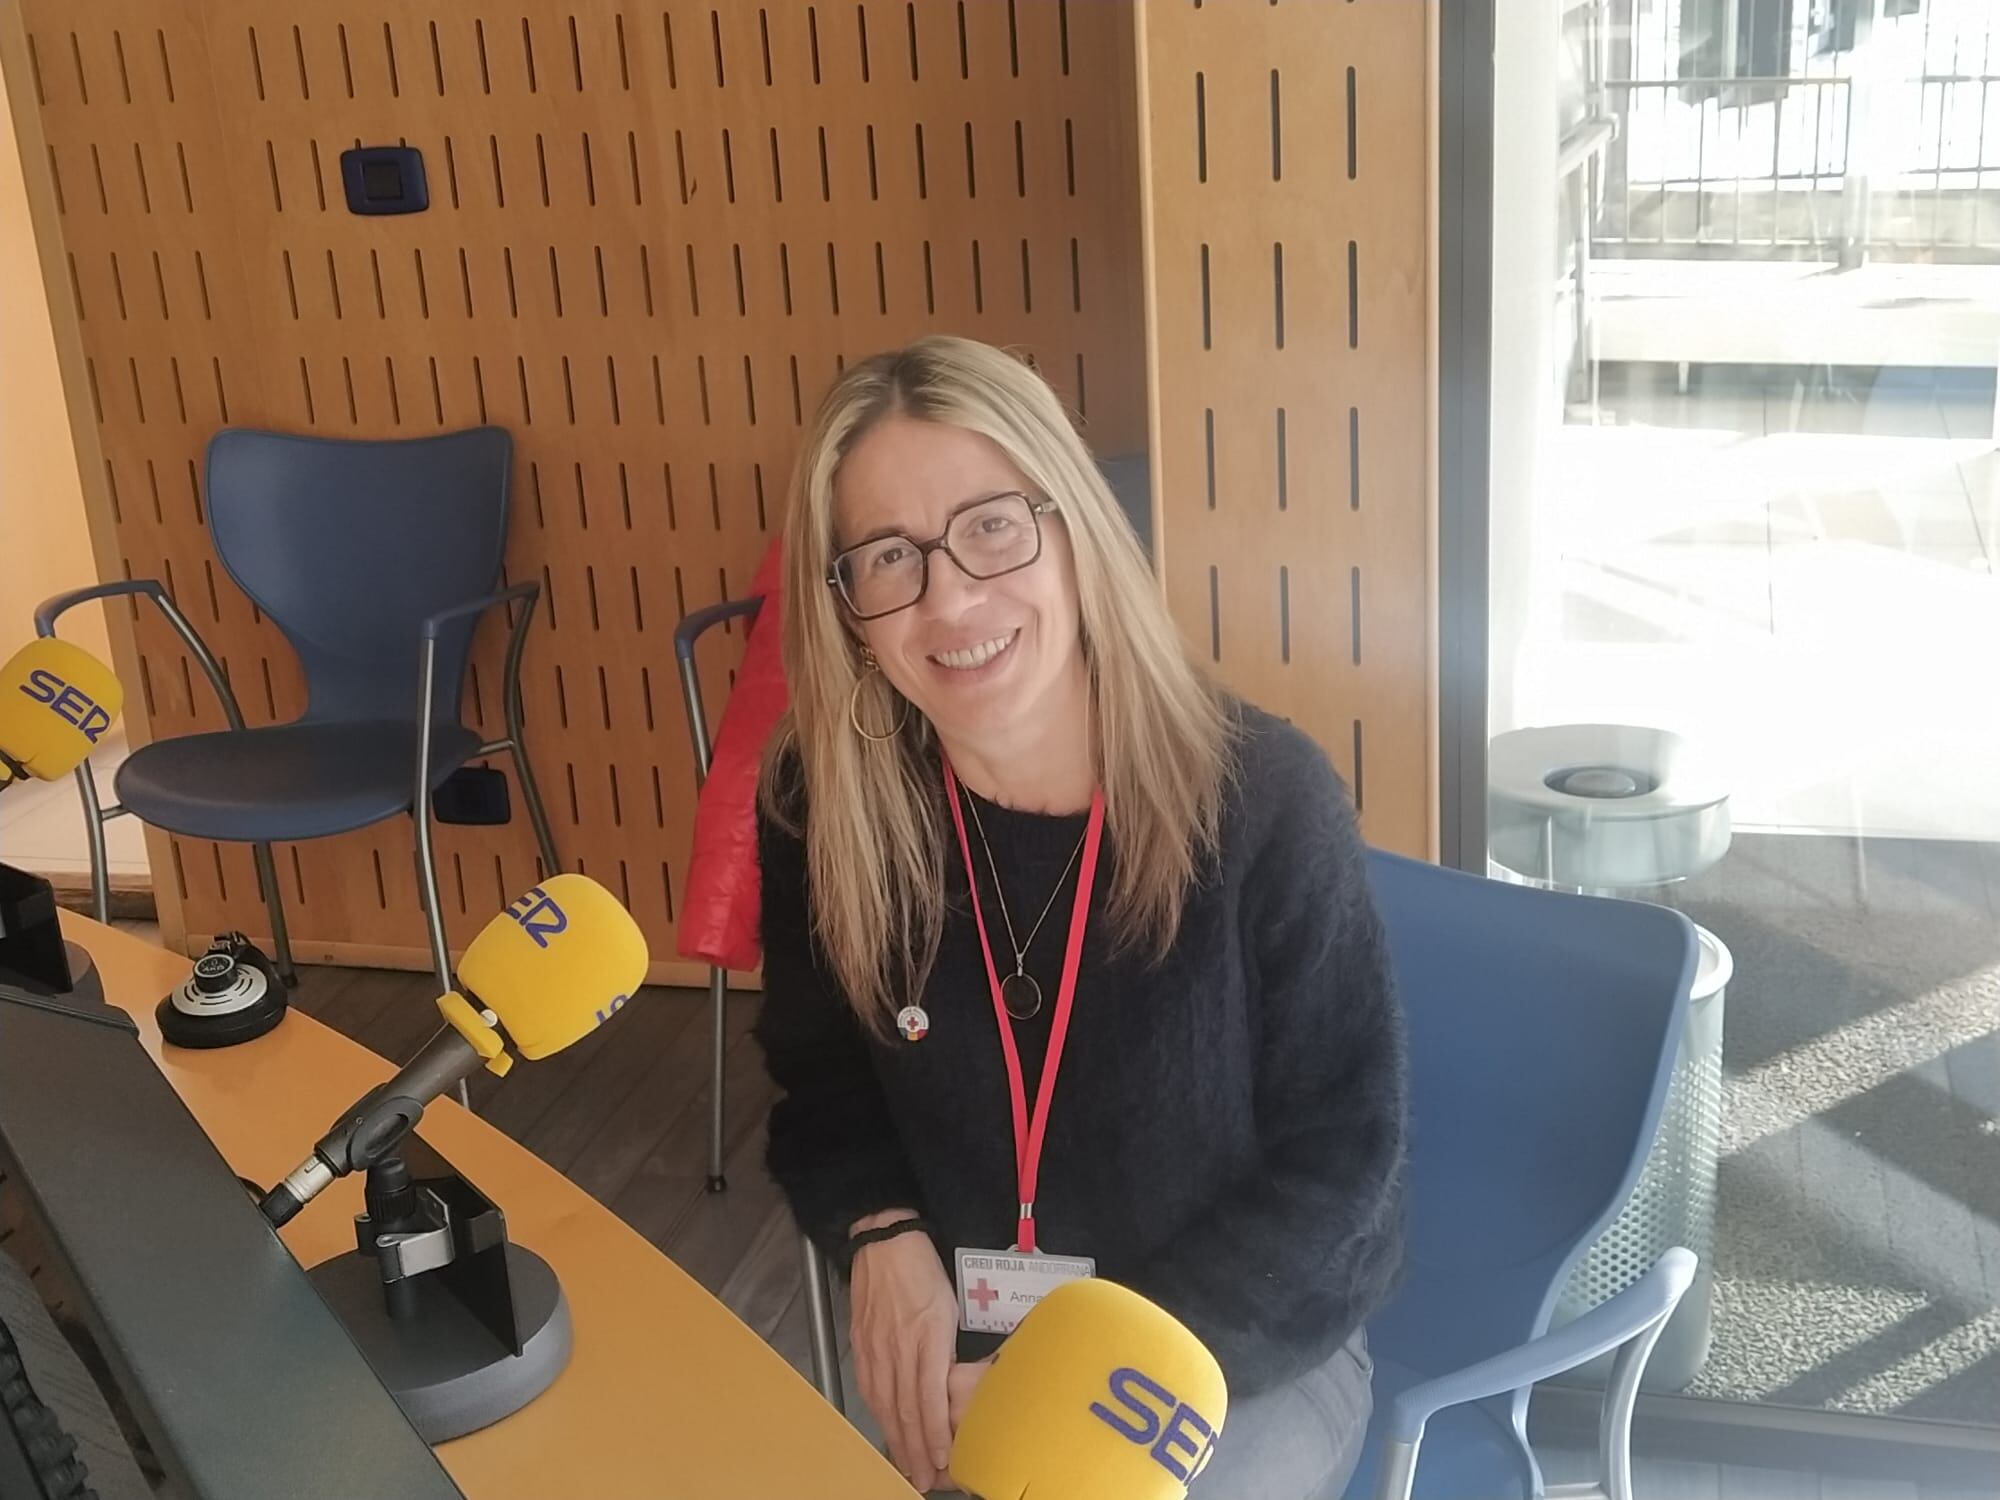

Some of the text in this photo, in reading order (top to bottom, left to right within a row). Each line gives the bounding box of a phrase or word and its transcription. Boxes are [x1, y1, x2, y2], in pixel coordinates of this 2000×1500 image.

[19, 669, 110, 744] SER
[964, 1257, 993, 1270] CREU
[995, 1259, 1025, 1272] ROJA
